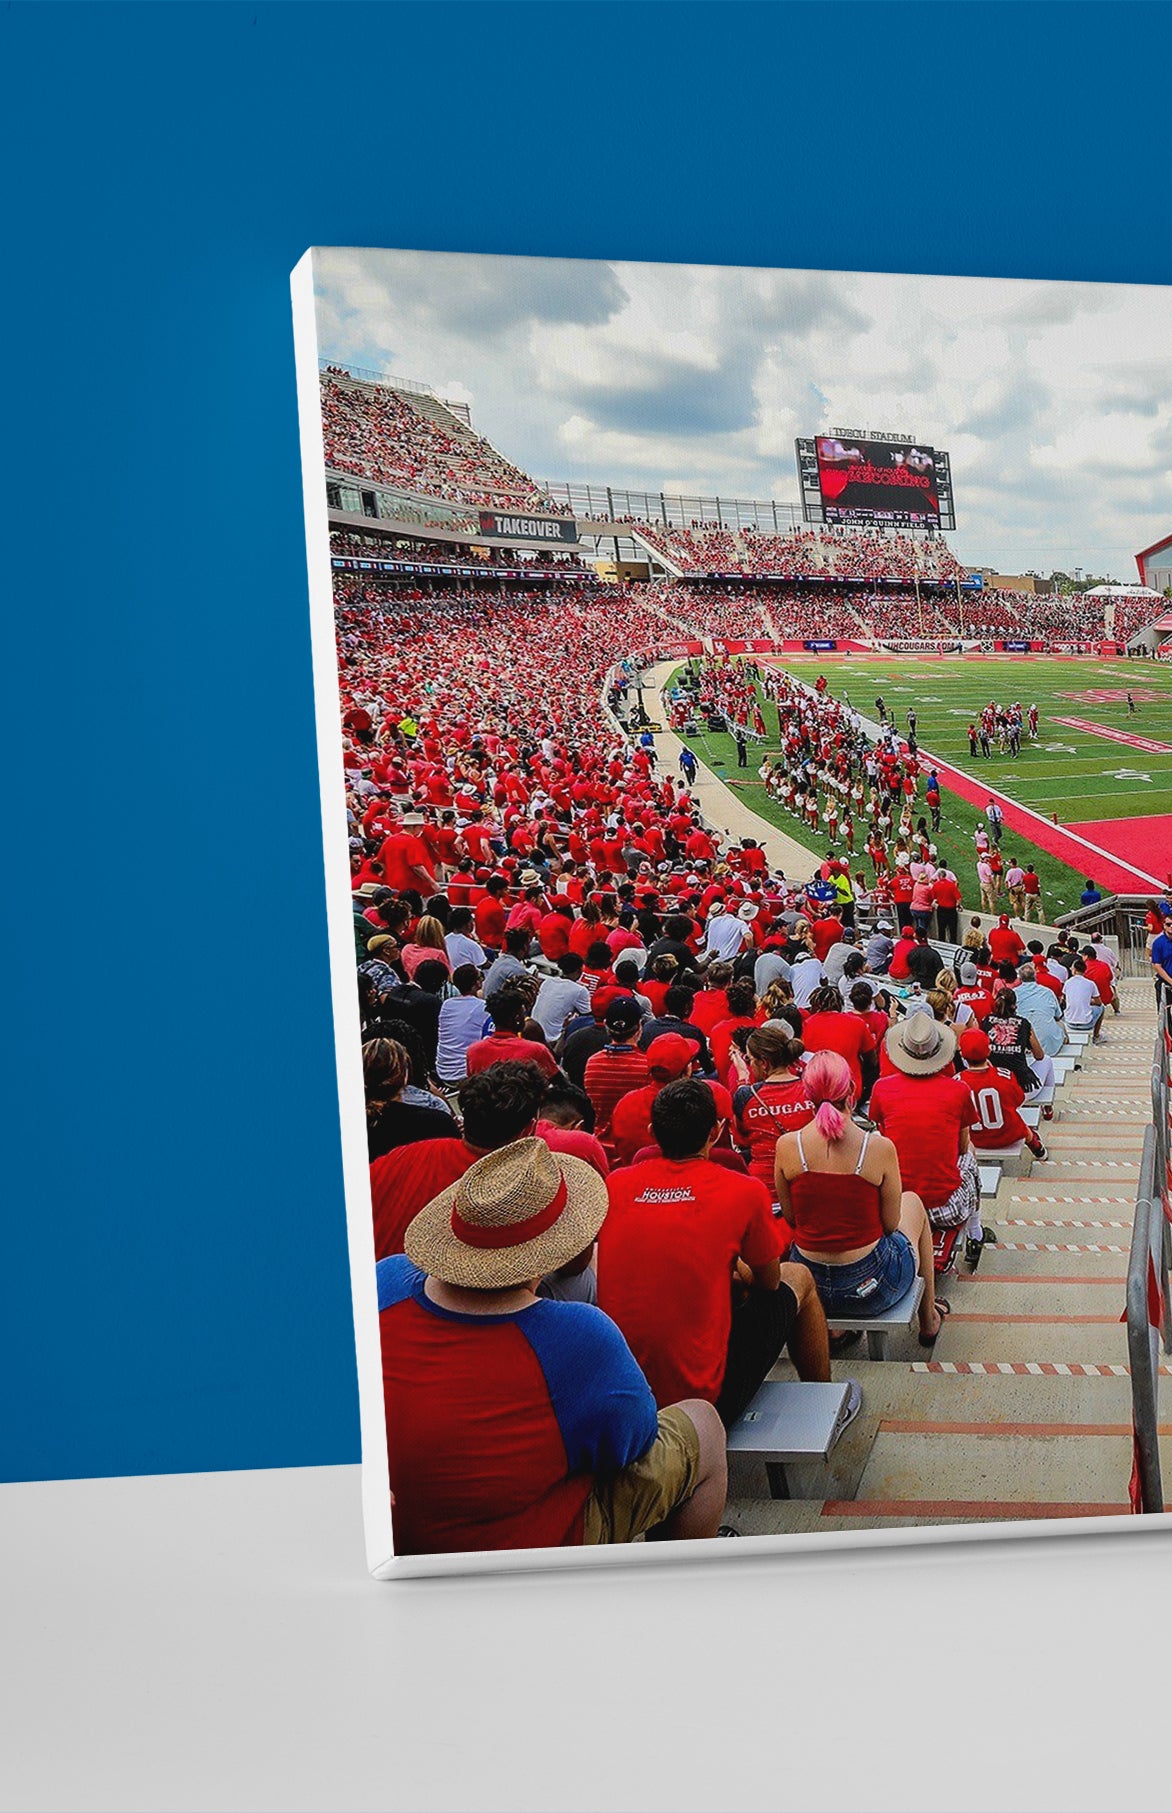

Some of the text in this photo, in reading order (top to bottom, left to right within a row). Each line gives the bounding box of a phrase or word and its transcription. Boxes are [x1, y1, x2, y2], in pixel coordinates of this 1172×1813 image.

[833, 427, 912, 443] TDECU STADIUM
[494, 516, 561, 538] TAKEOVER
[865, 519, 899, 527] O'QUINN
[642, 1189, 691, 1200] HOUSTON
